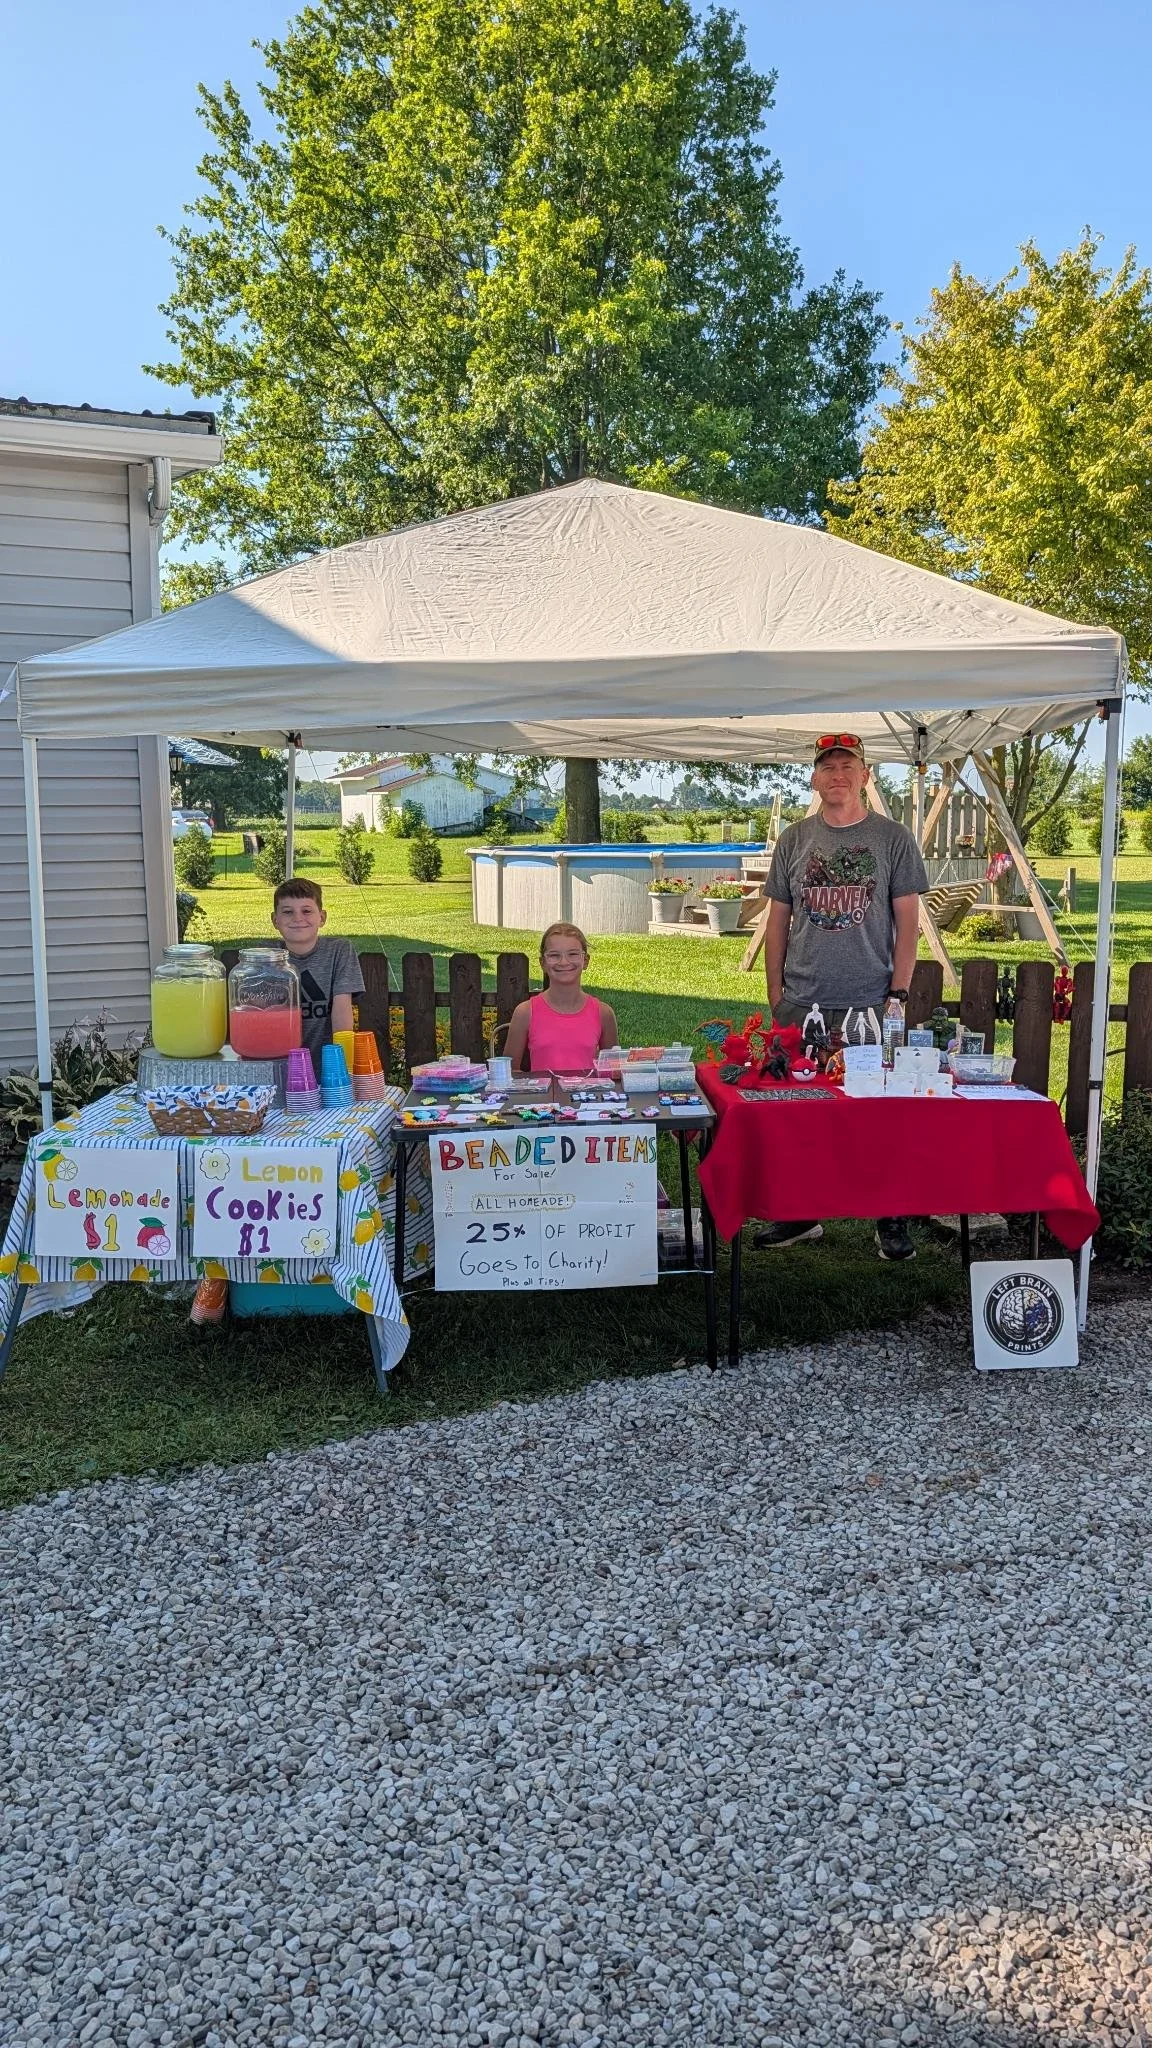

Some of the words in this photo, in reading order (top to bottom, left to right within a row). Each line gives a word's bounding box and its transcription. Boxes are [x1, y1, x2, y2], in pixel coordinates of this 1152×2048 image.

[803, 886, 870, 914] MARVEL
[438, 1134, 576, 1171] BEADED
[585, 1136, 656, 1163] ITEMS
[242, 1157, 323, 1183] Lemon
[493, 1168, 516, 1181] For
[525, 1168, 556, 1179] Sale!
[48, 1183, 170, 1209] Lemonade
[475, 1198, 502, 1210] ALL
[508, 1196, 570, 1209] HOMEADE!
[83, 1212, 120, 1252] $1
[238, 1223, 270, 1257] $1
[465, 1222, 526, 1244] 25%
[544, 1224, 567, 1239] OF
[579, 1223, 636, 1239] PROFIT
[459, 1250, 518, 1277] Goes
[548, 1249, 609, 1274] Charity!
[502, 1277, 519, 1288] Plus
[523, 1277, 534, 1286] all
[991, 1277, 1016, 1300] LEFT
[1020, 1276, 1053, 1297] BRAIN
[1008, 1341, 1043, 1351] PRINTS
